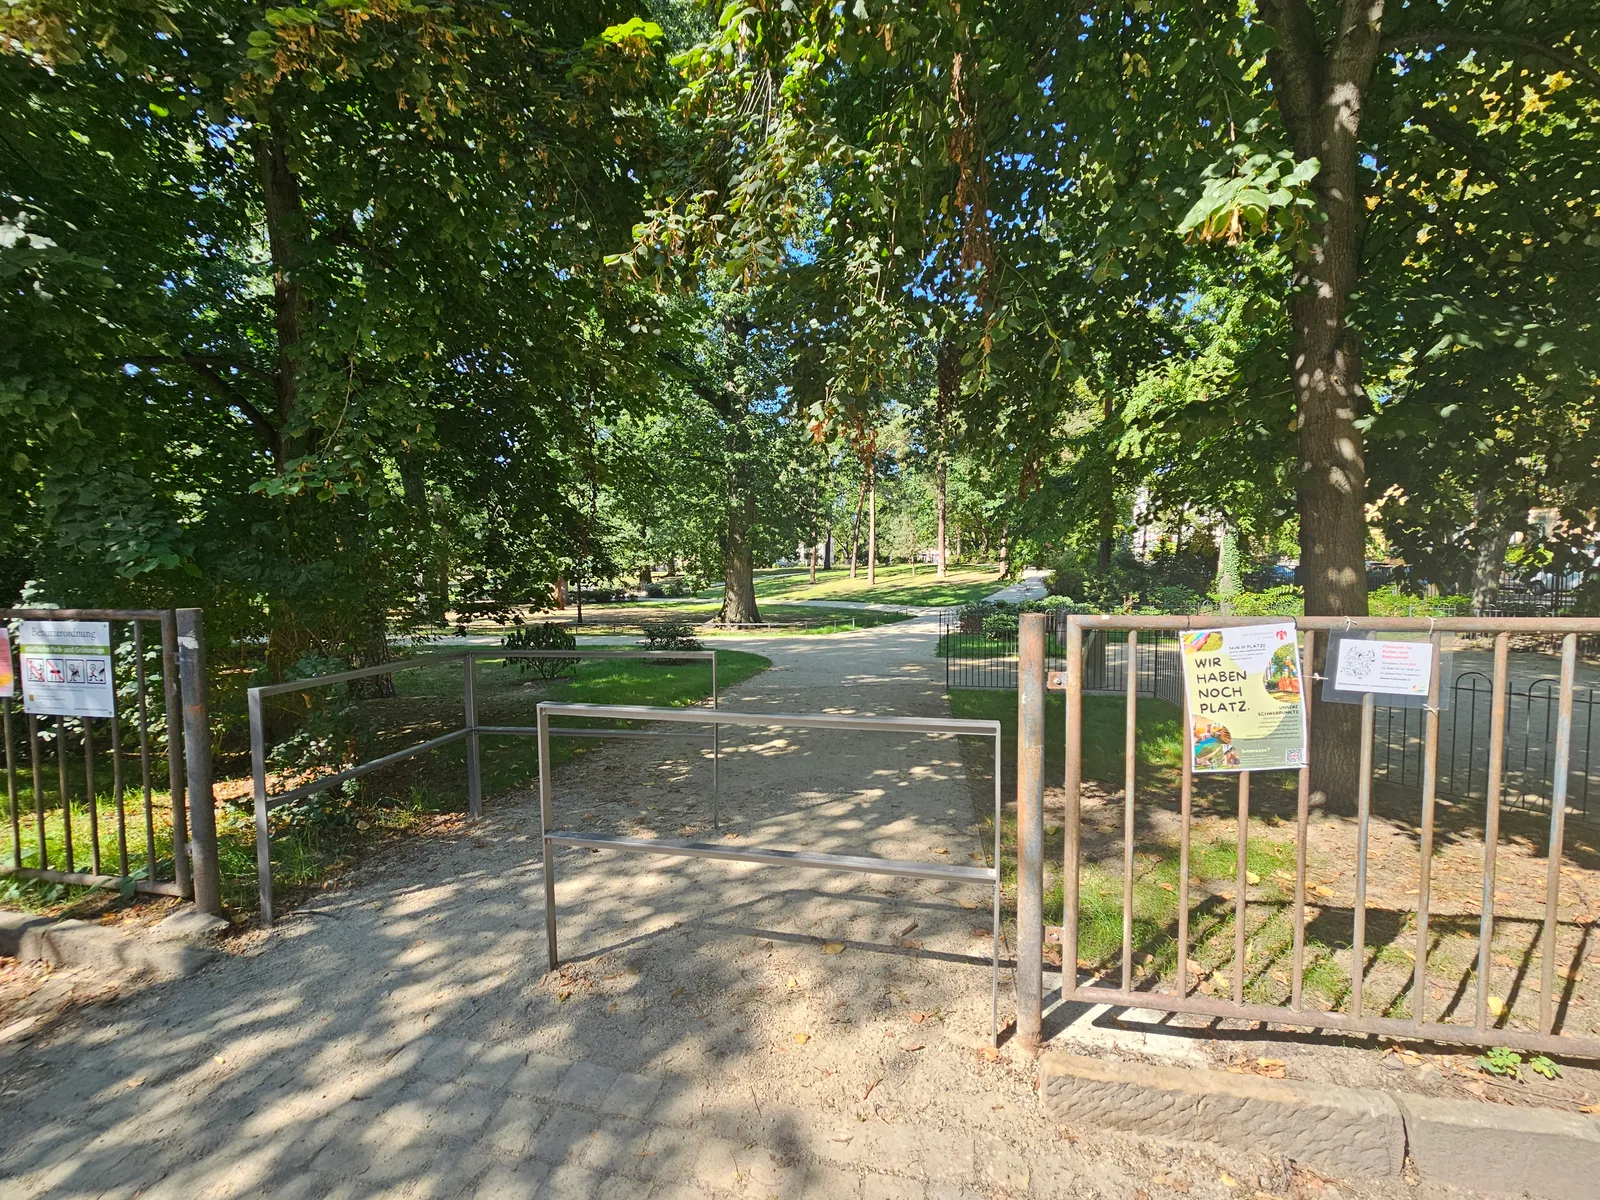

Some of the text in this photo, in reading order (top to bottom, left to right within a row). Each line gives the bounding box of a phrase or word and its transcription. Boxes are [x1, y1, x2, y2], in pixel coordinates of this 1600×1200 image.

[31, 627, 96, 641] Benutzerordnung
[1195, 657, 1222, 668] WIR
[1197, 670, 1247, 684] HABEN
[1199, 686, 1242, 699] NOCH
[1200, 701, 1250, 714] PLATZ.
